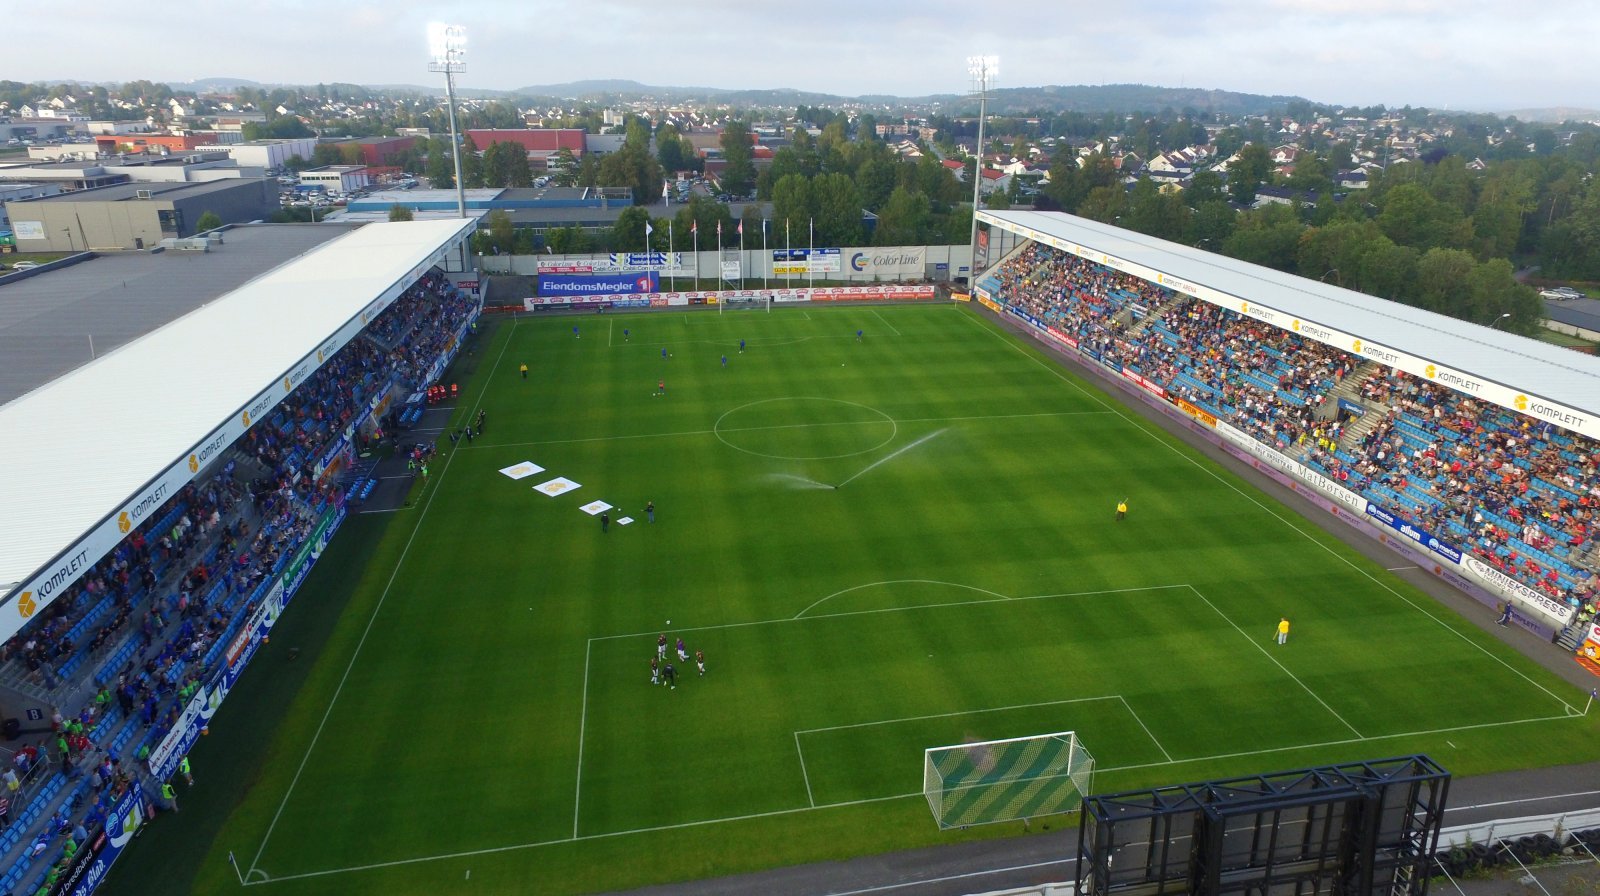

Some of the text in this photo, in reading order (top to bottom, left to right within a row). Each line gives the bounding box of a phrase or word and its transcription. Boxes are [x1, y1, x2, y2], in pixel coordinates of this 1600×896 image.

[874, 254, 919, 267] Color Line
[543, 279, 647, 293] EiendomsMegler 1
[1163, 277, 1182, 289] KOMPLETT
[1249, 305, 1275, 321] KOMPLETT
[1301, 323, 1332, 341] KOMPLETT
[1363, 345, 1399, 364] KOMPLETT
[290, 364, 308, 385] KOMPLETT
[1438, 371, 1482, 393] KOMPLETT
[250, 396, 273, 420] KOMPLETT
[1182, 401, 1217, 428] JOTUN JOTUN
[1530, 402, 1585, 429] KOMPLETT
[198, 434, 227, 464] KOMPLETT
[1297, 464, 1359, 508] MatBørsen
[131, 483, 168, 521] KOMPLETT
[1338, 509, 1360, 527] KOMPLETT
[1400, 524, 1421, 541] allum
[1438, 544, 1460, 560] marine
[37, 550, 89, 602] KOMPLETT
[1442, 571, 1471, 591] KOMPLETT
[31, 708, 40, 721] B
[64, 849, 93, 891] bredbånd
